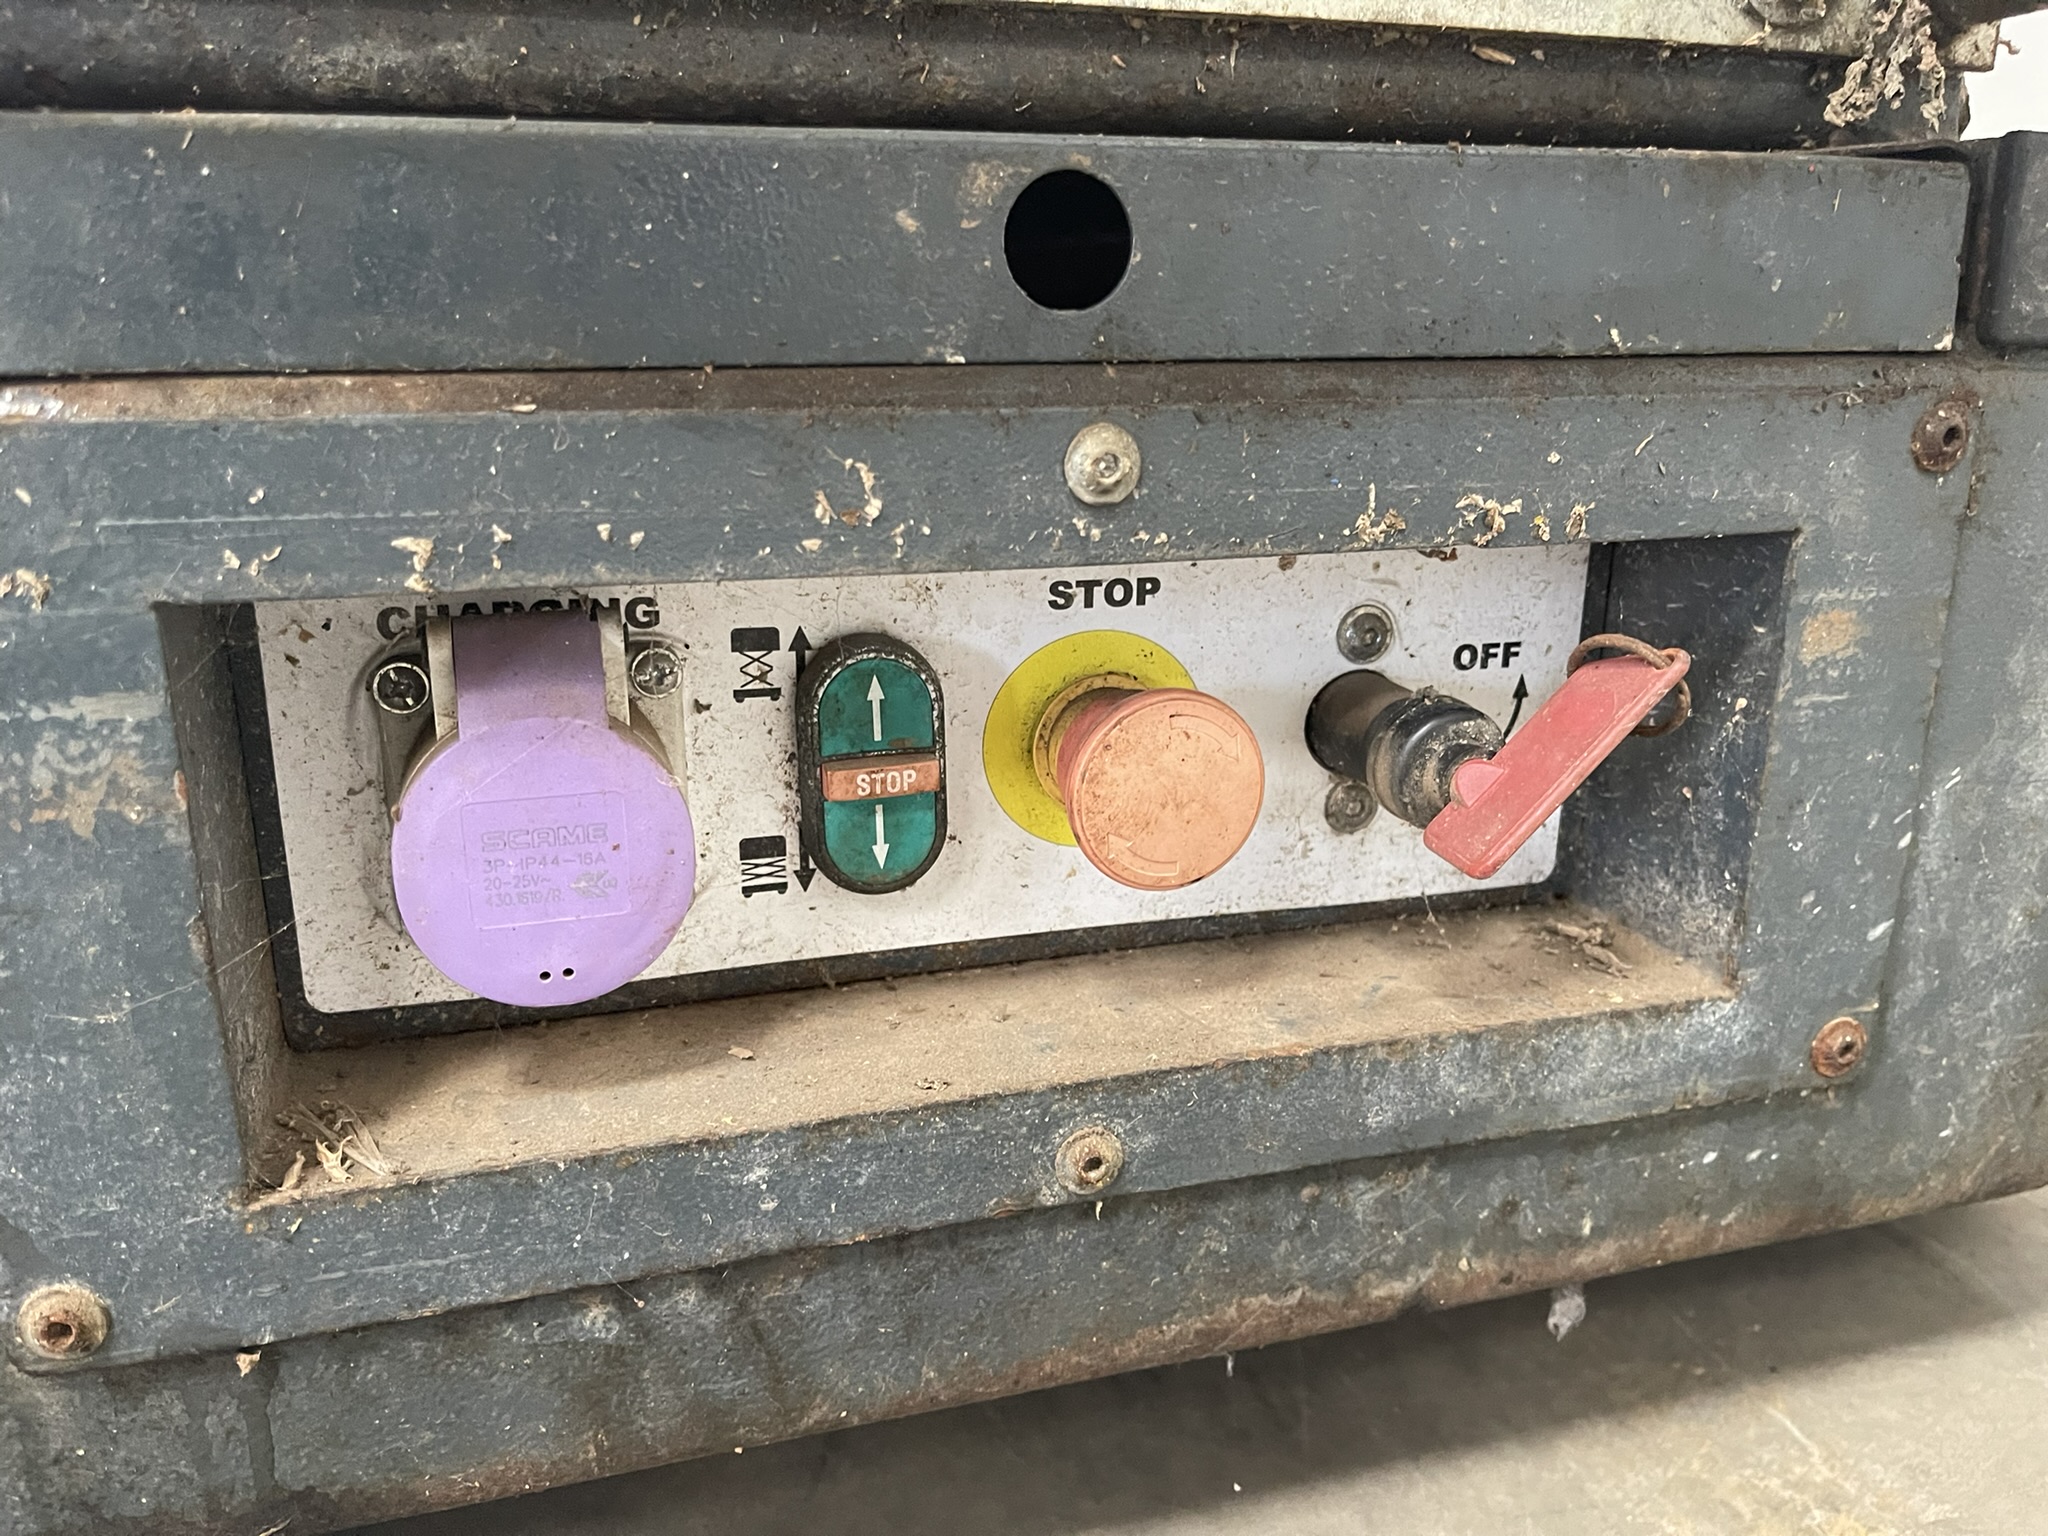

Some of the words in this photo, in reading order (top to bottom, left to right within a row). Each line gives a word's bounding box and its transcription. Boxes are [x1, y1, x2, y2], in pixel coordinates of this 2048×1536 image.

[1048, 577, 1161, 610] STOP
[1453, 641, 1522, 671] OFF
[855, 769, 917, 796] STOP
[480, 822, 609, 852] SCAME
